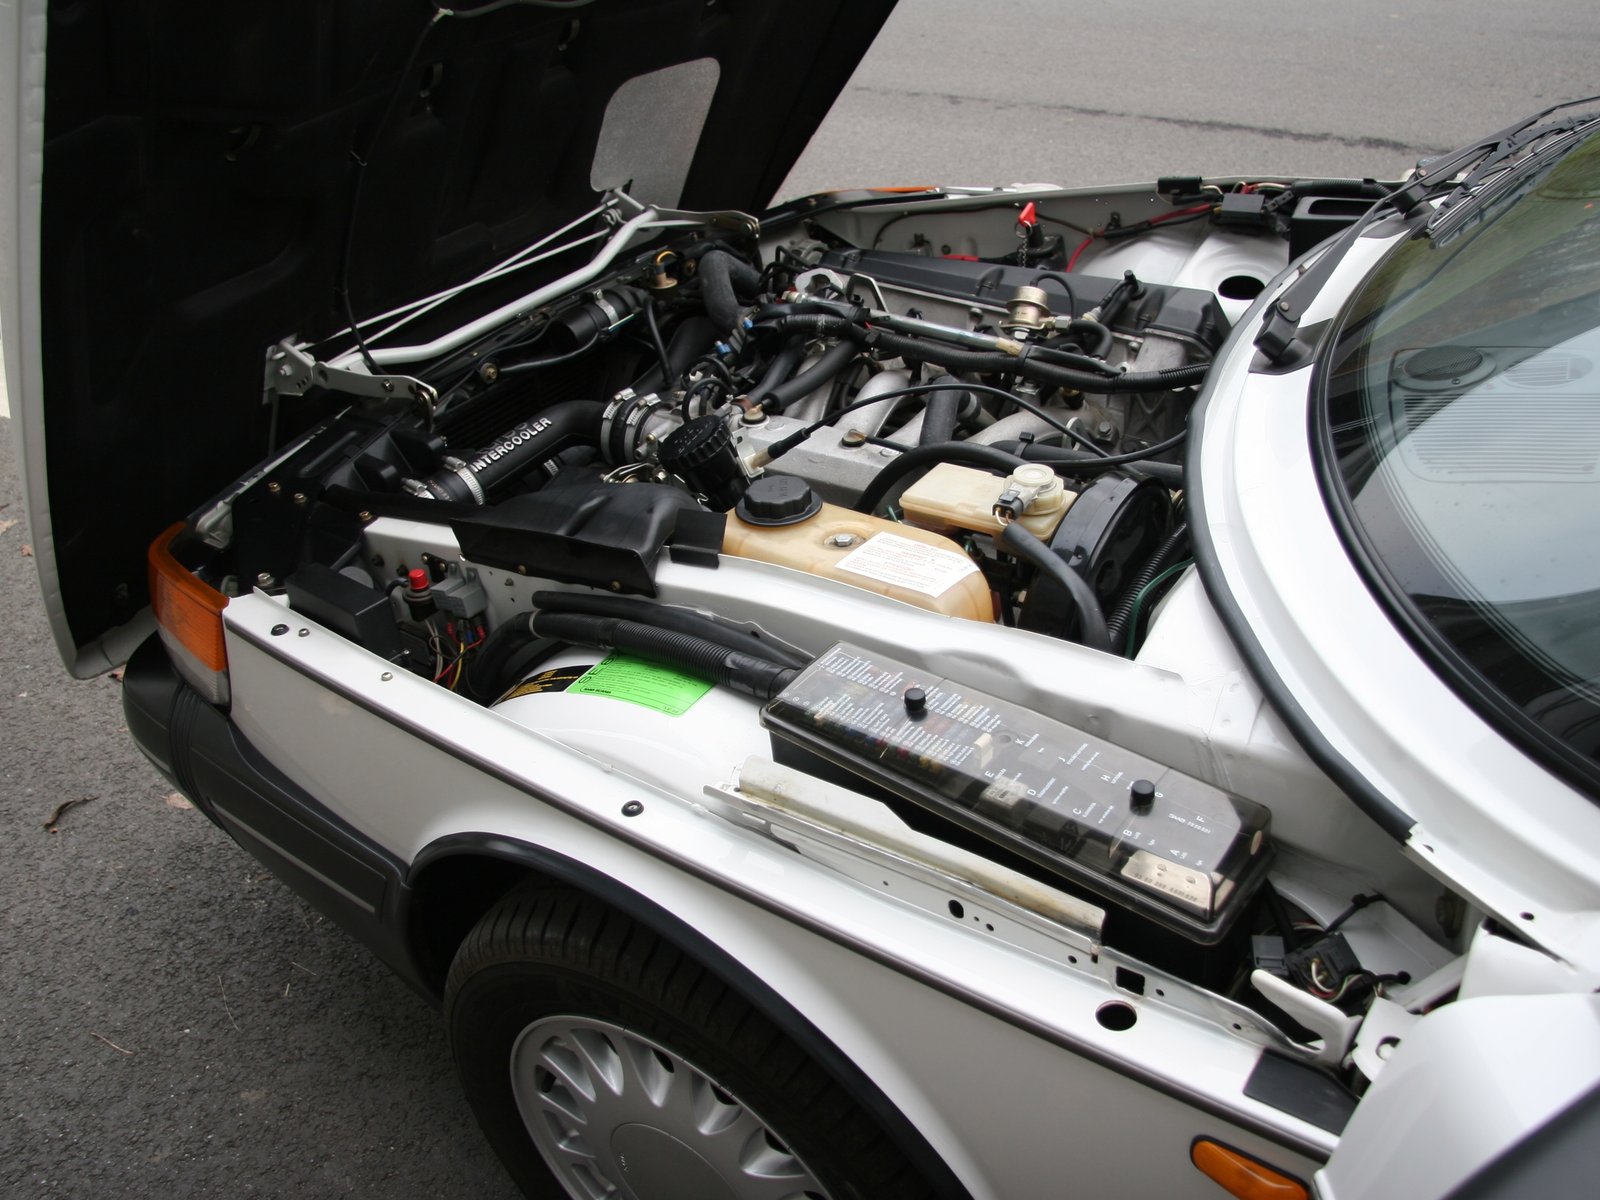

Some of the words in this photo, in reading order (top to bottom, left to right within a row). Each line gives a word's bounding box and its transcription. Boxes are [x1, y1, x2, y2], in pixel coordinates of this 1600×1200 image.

[469, 417, 552, 473] INTERCOOLER
[984, 770, 995, 778] E
[1100, 774, 1111, 782] H
[1026, 788, 1037, 796] D
[1123, 829, 1133, 837] B
[1169, 849, 1180, 857] A
